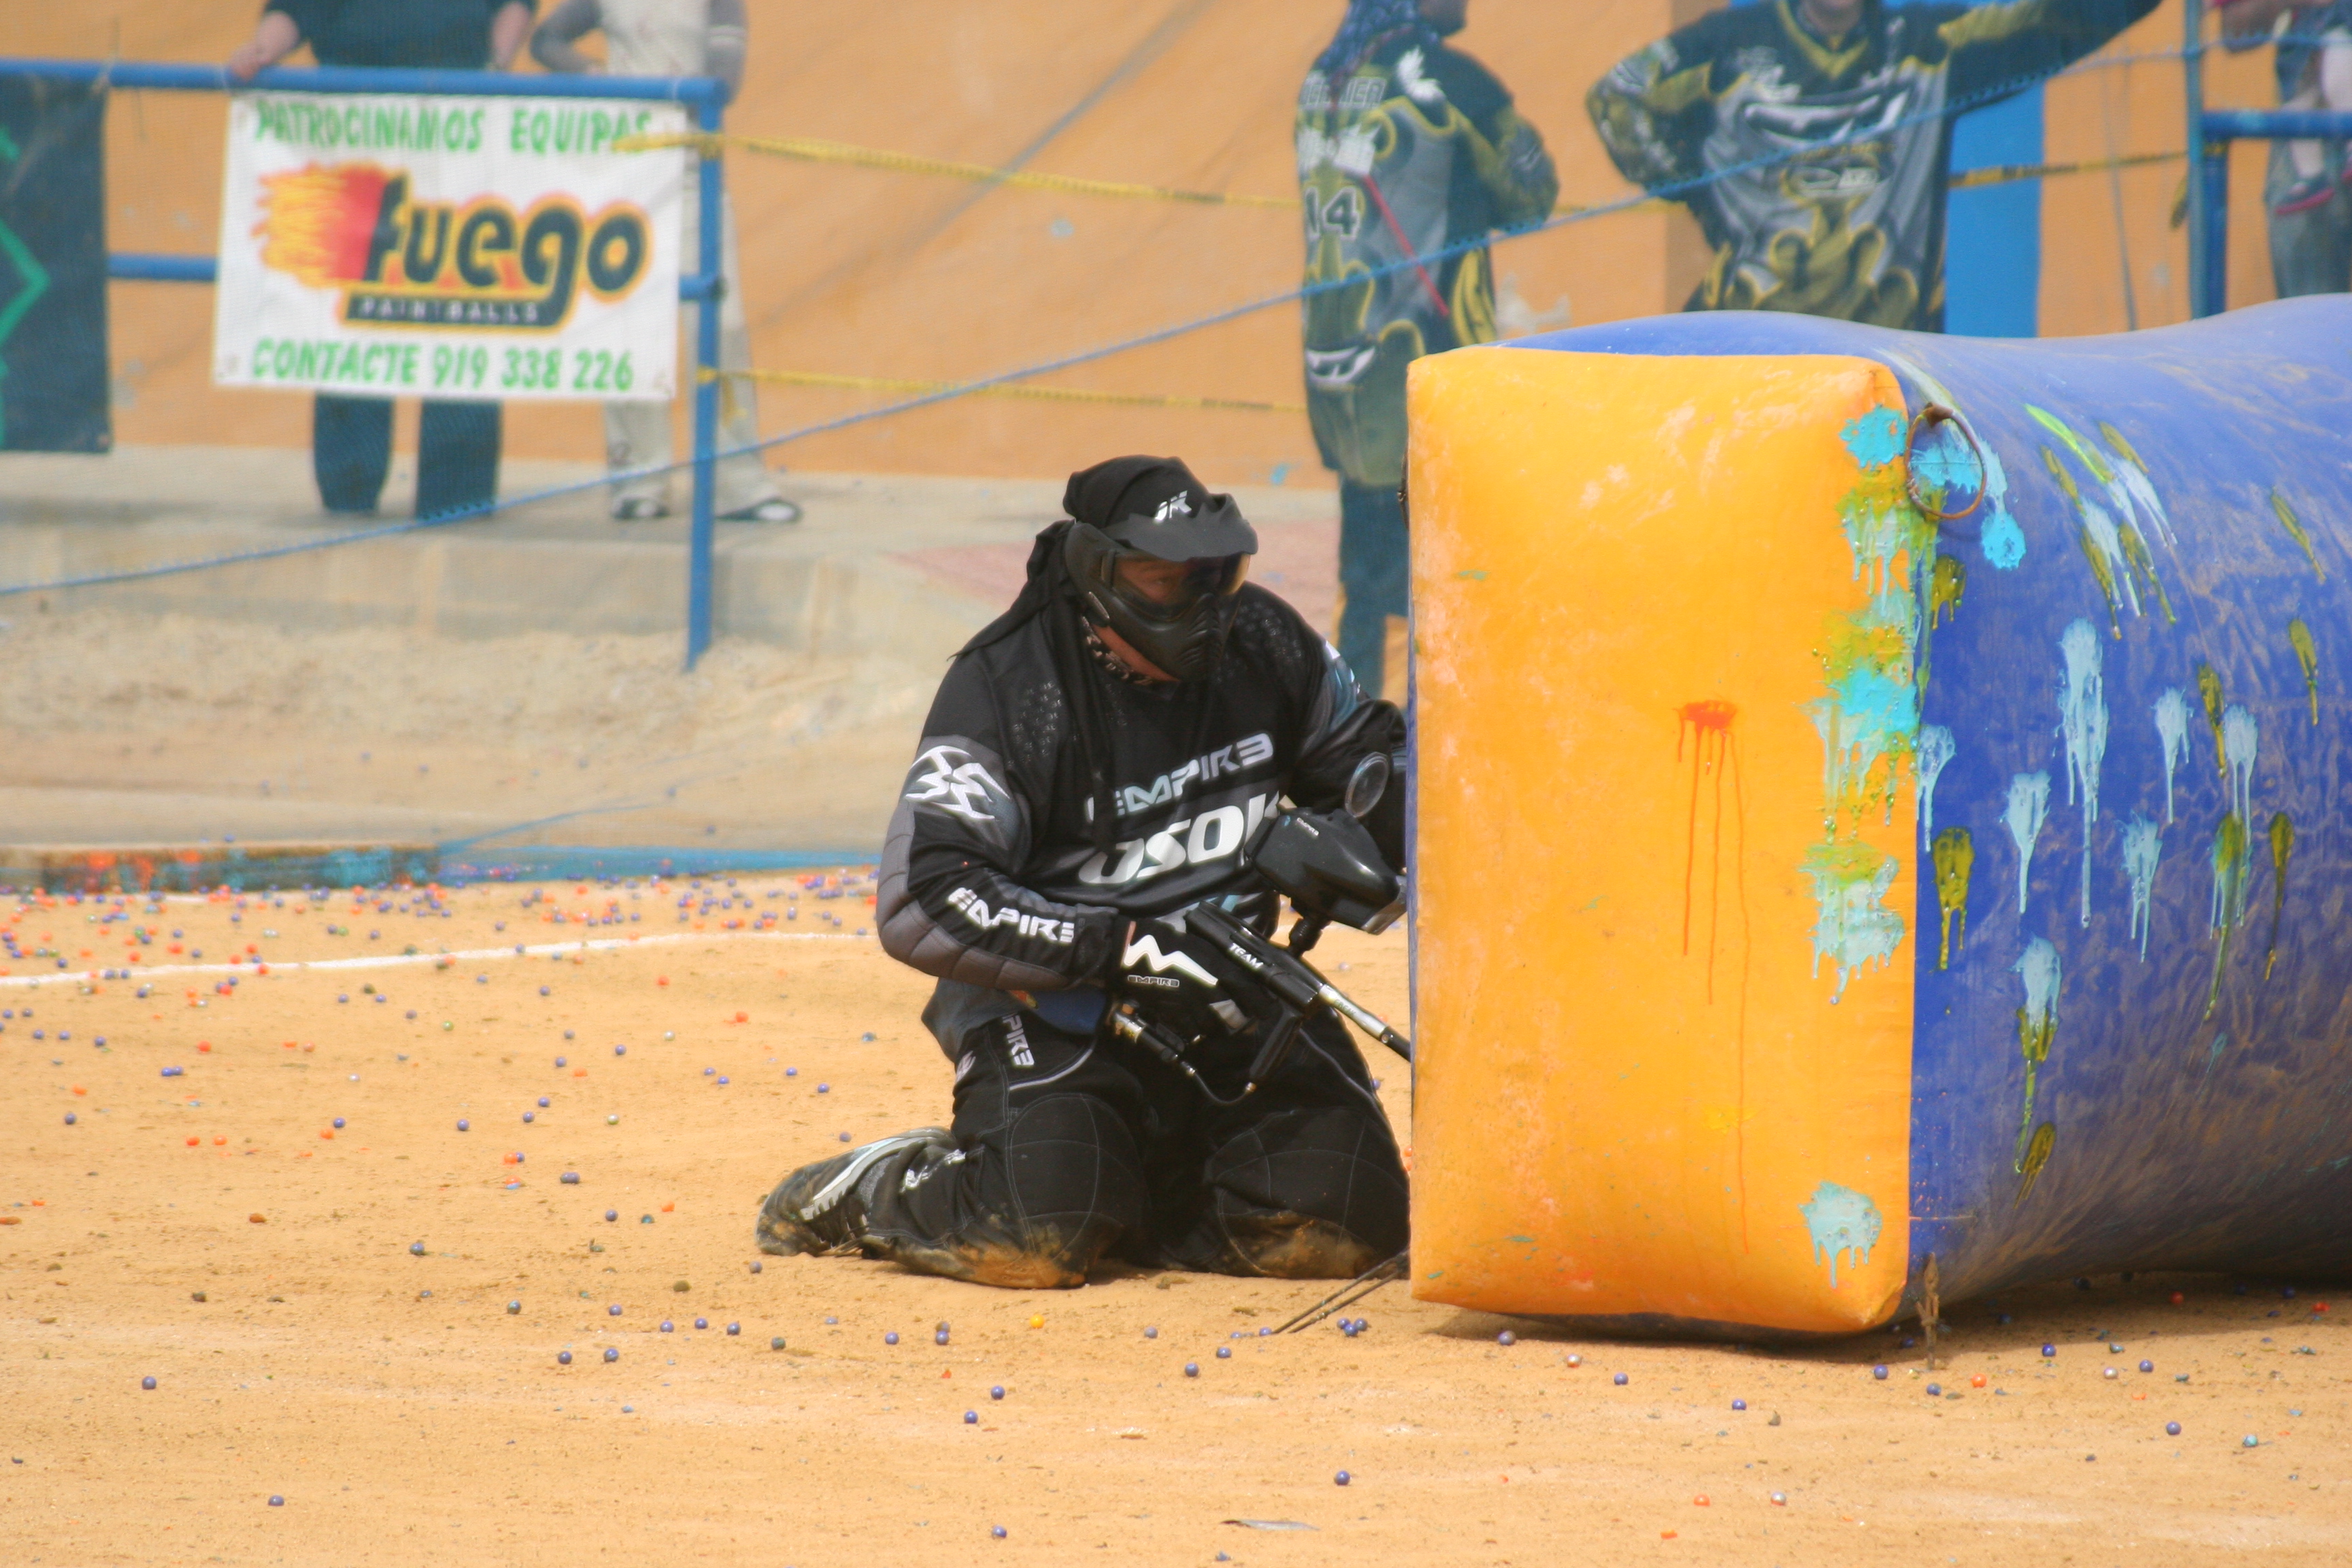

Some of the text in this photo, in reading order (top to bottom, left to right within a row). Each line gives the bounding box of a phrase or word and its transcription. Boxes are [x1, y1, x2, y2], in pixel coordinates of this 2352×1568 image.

[252, 340, 634, 393] CONTACTE 919 338 226
[947, 887, 1075, 943] EMPIRE
[1228, 942, 1264, 969] TEAM
[1002, 1013, 1035, 1066] PIRE
